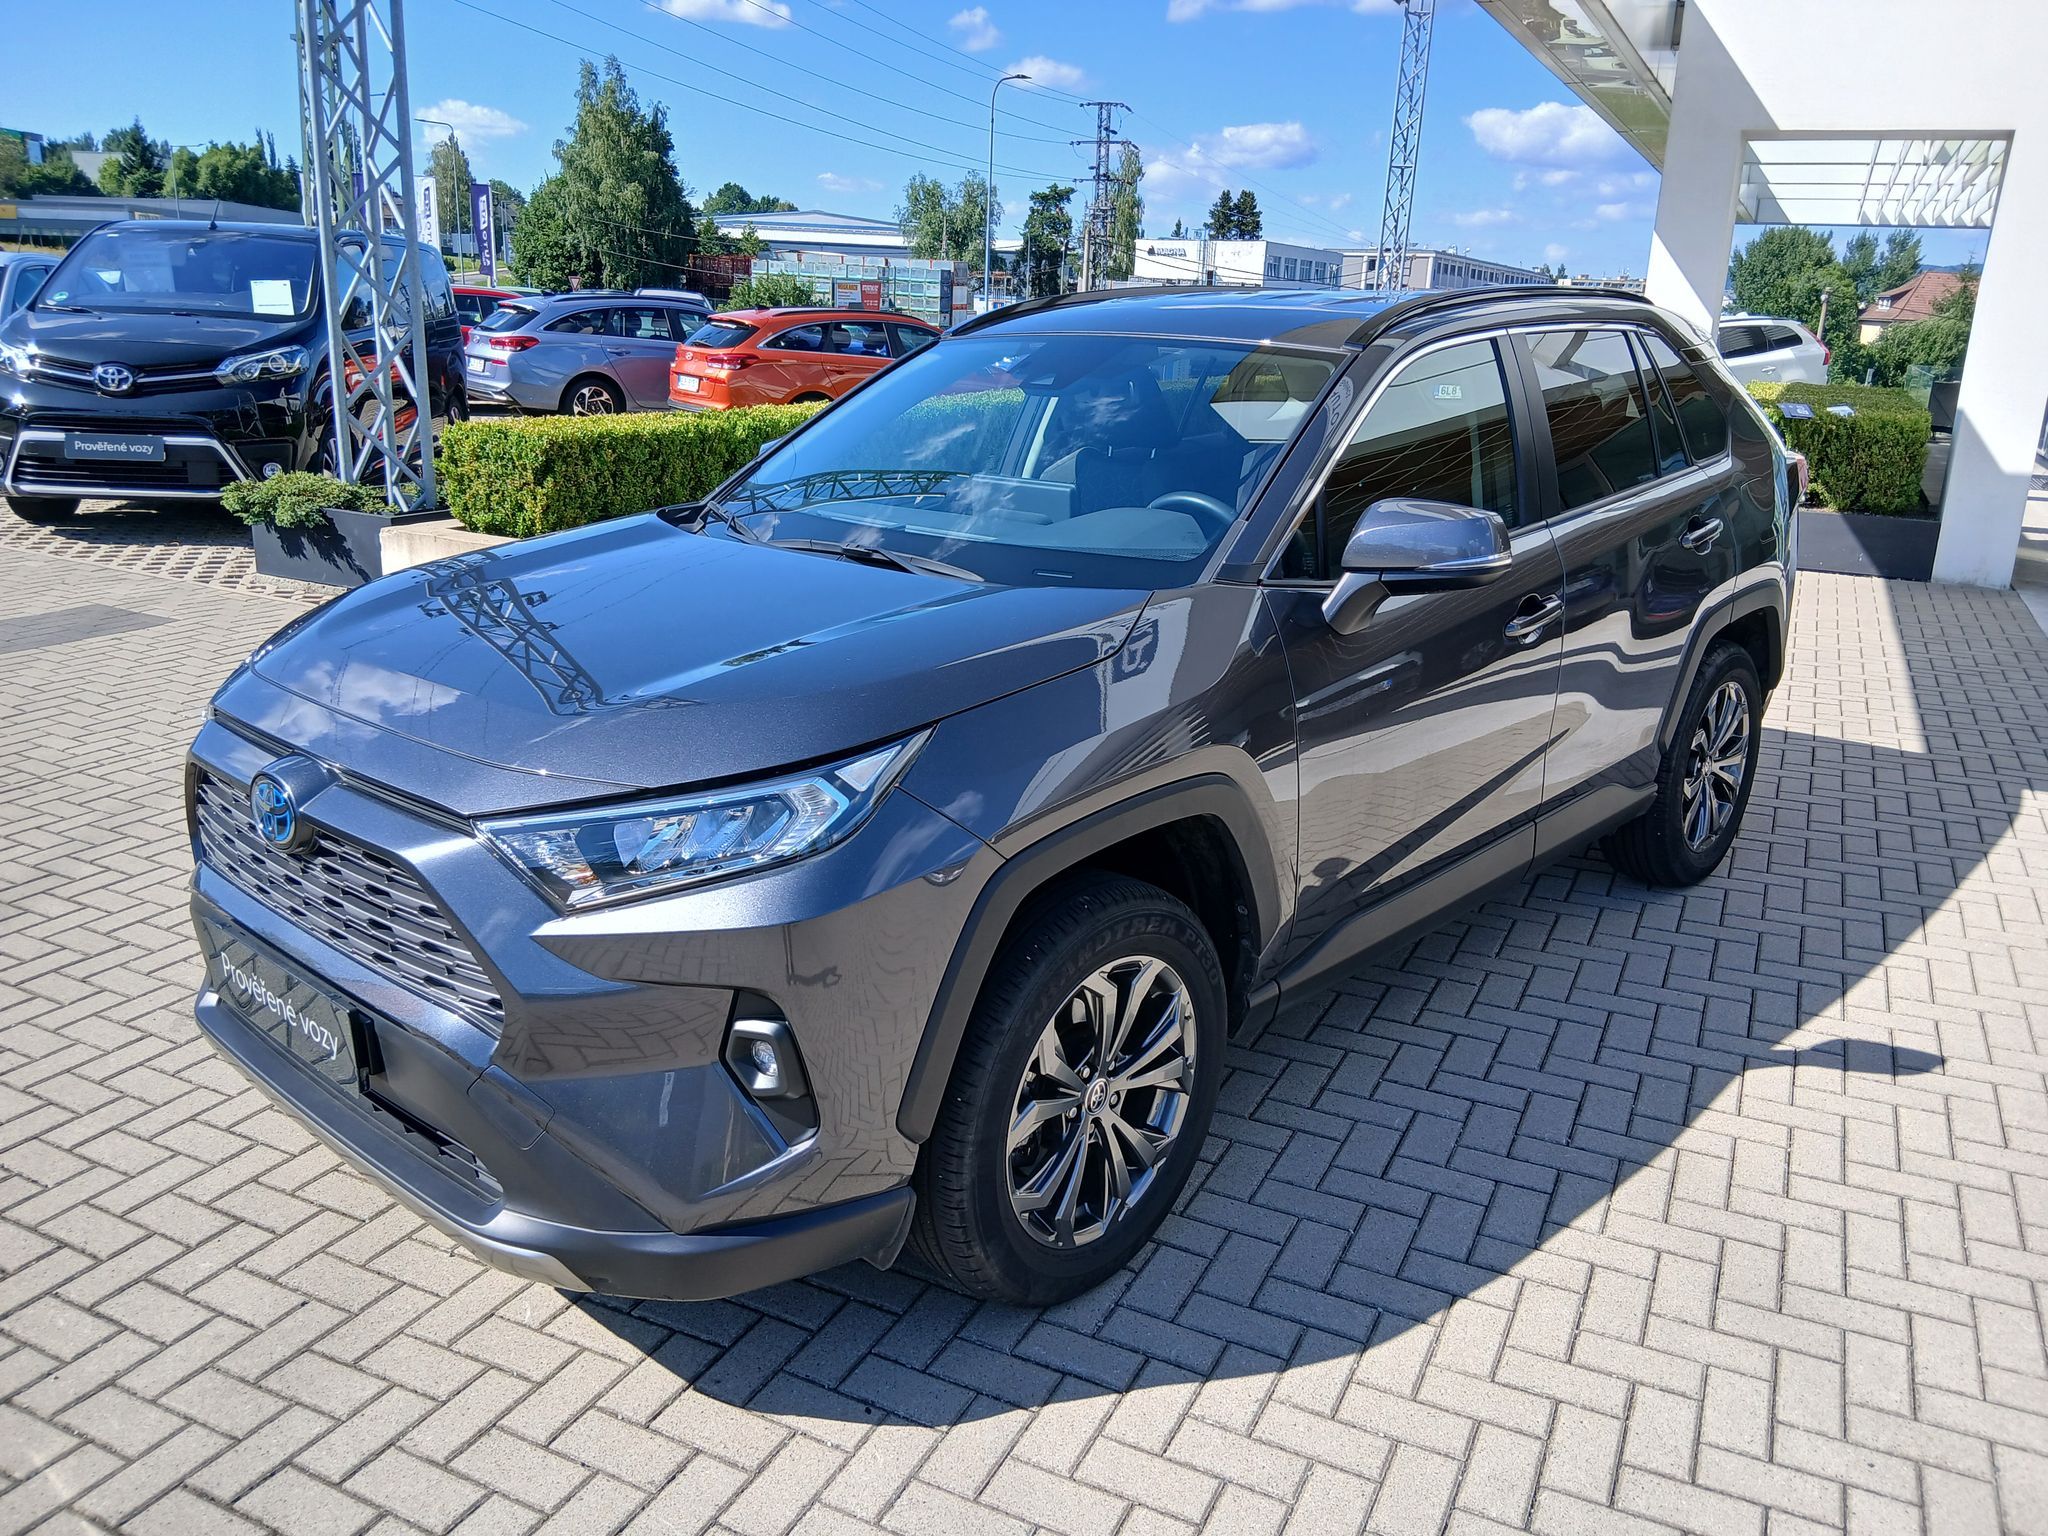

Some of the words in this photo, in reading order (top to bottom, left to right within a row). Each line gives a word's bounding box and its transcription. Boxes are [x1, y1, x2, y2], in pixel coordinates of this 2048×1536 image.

[1156, 247, 1187, 257] MAGNA
[74, 440, 128, 452] Prověřené
[128, 444, 154, 455] vozy
[220, 951, 297, 1027] Prověřené
[299, 1012, 338, 1061] vozy
